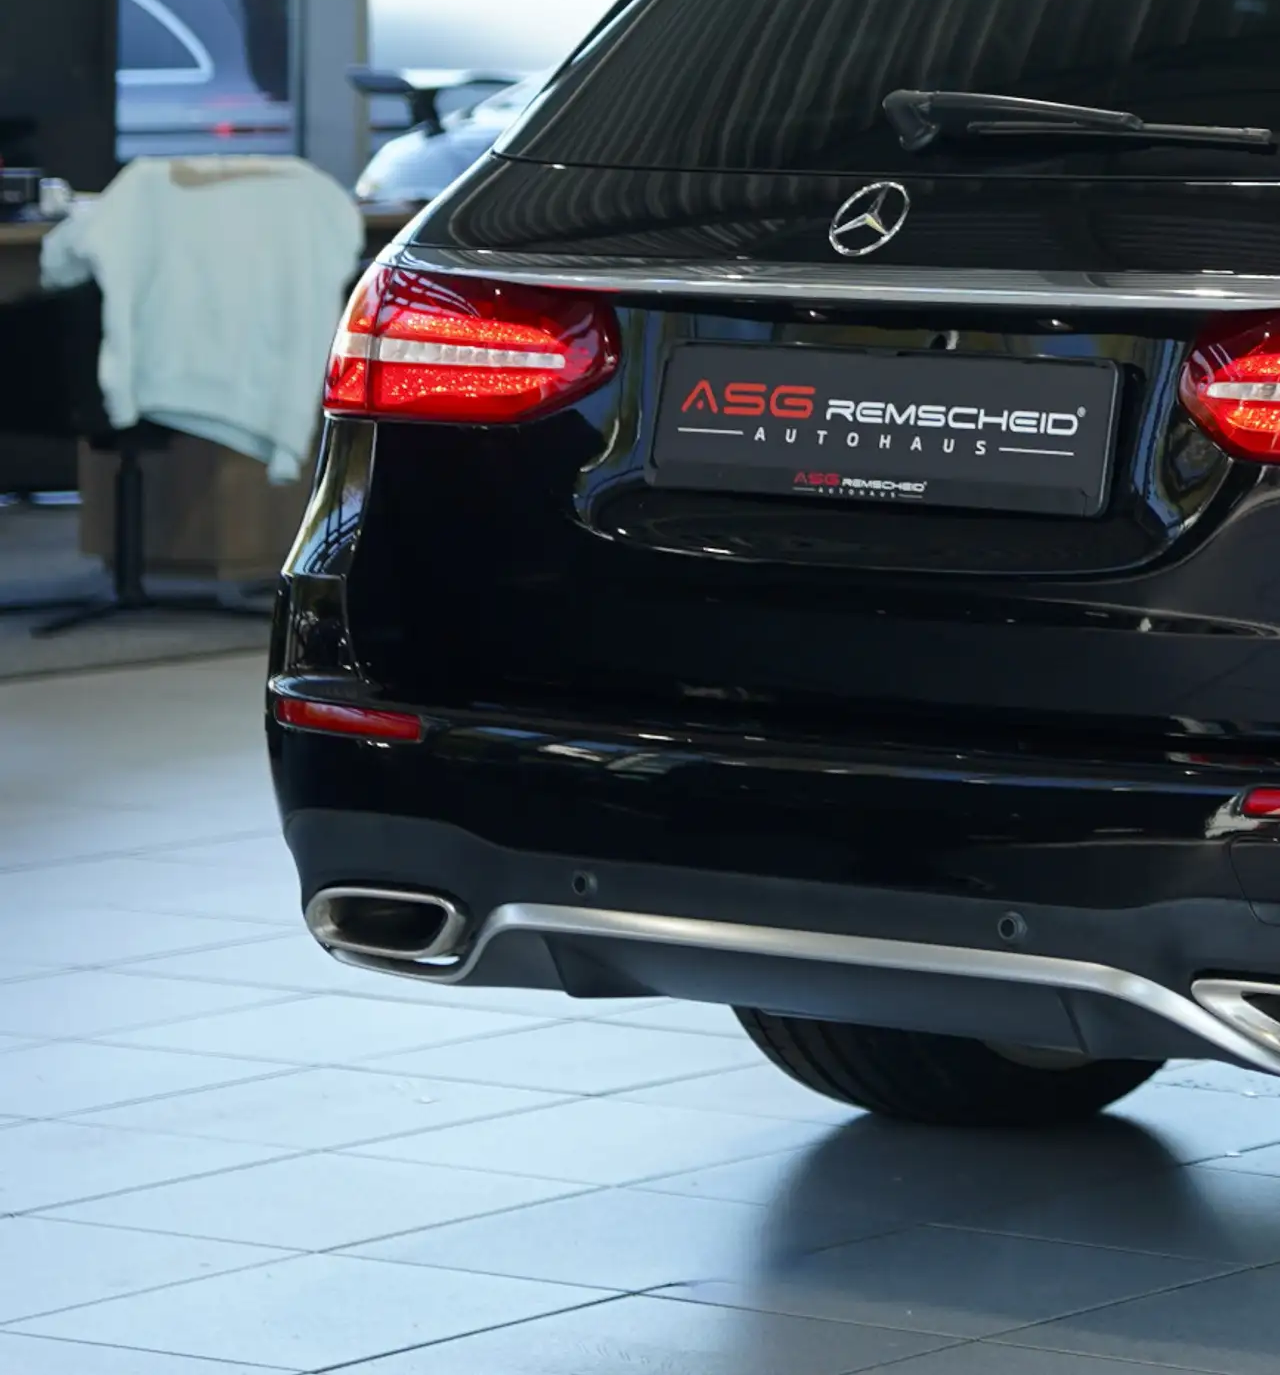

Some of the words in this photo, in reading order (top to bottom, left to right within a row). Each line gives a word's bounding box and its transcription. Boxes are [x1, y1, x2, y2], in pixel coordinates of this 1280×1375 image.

[680, 379, 816, 419] ASG
[753, 426, 987, 456] AUTOHAUS
[793, 471, 840, 486] ASG
